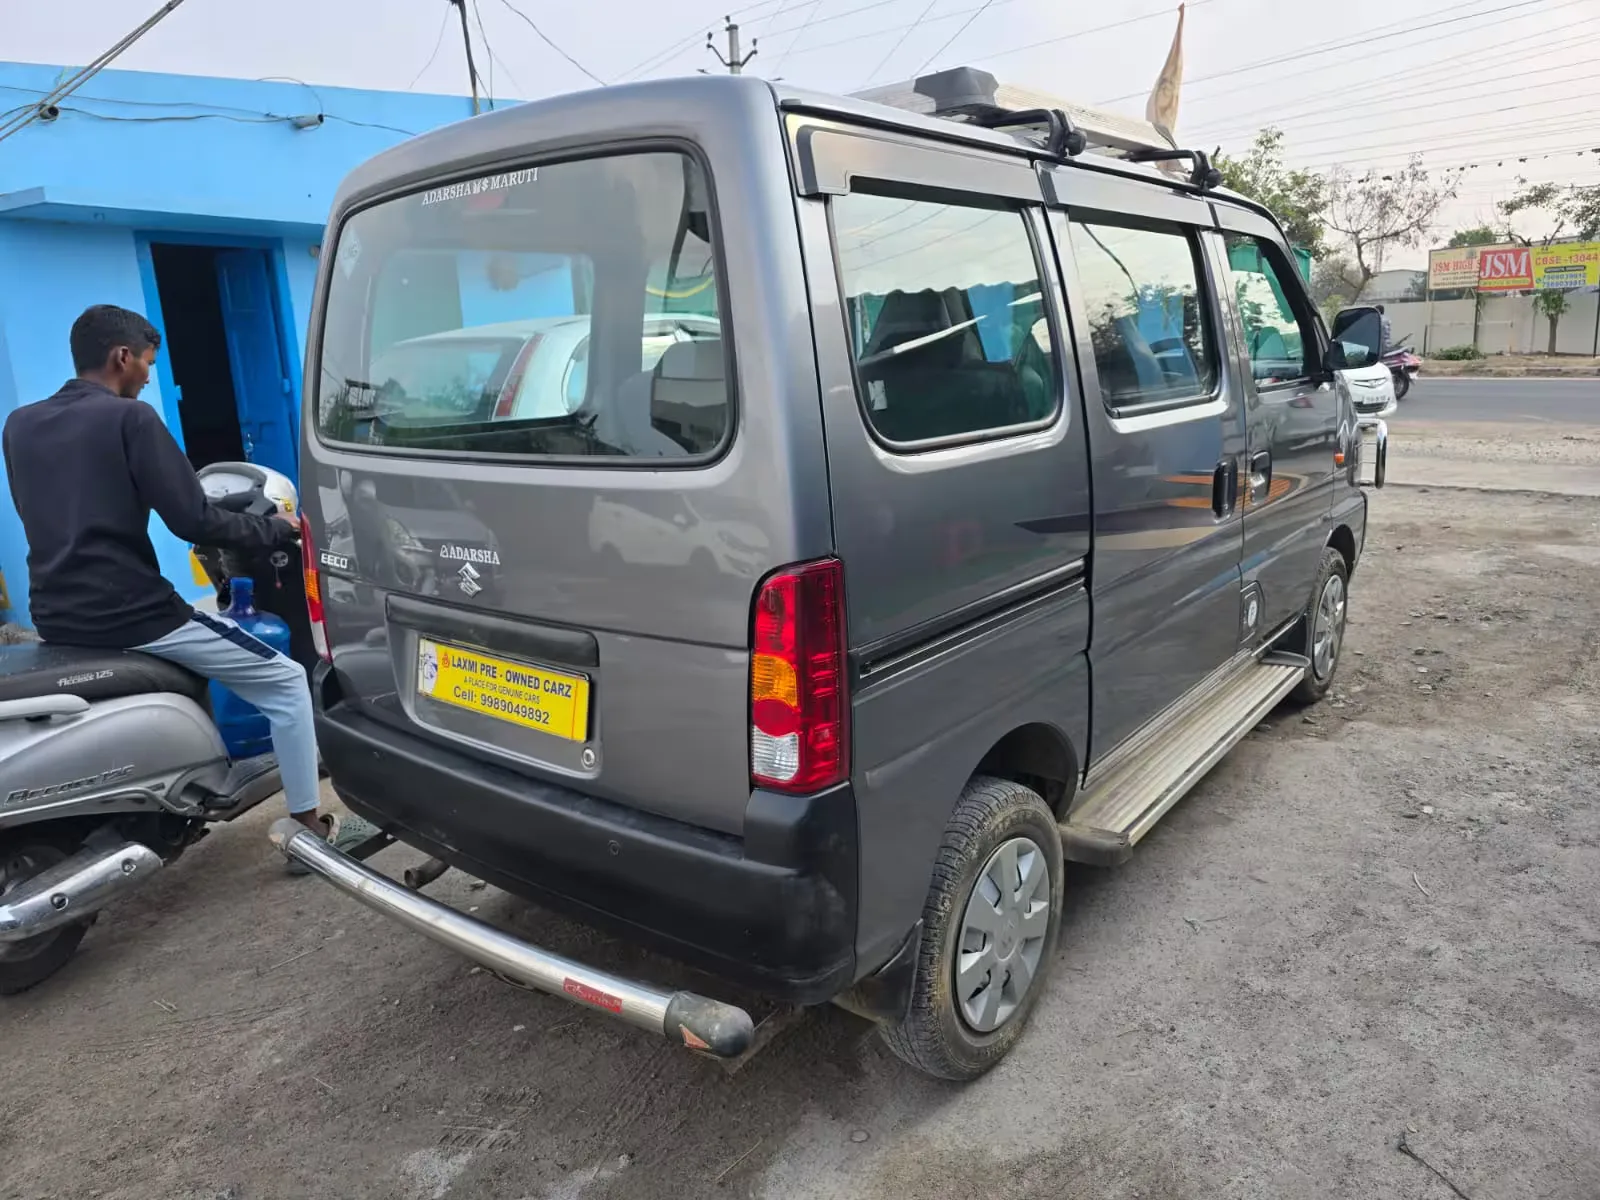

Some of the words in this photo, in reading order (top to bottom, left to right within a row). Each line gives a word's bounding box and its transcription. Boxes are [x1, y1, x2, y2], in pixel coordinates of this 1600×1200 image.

[422, 183, 471, 206] ADARSHA
[490, 167, 539, 190] MARUTI
[1432, 260, 1452, 273] JSM
[1453, 257, 1474, 271] HIGH
[1481, 251, 1529, 279] JSM
[320, 552, 348, 569] EECO
[449, 546, 500, 565] ADARSHA
[95, 669, 114, 681] 125
[451, 655, 478, 674] LAXMI
[480, 663, 497, 679] PRE
[505, 669, 540, 690] OWNED
[543, 678, 573, 699] CARZ
[453, 685, 477, 704] Cell:
[480, 693, 550, 725] 9989049892
[469, 677, 485, 689] PLACE
[486, 681, 498, 692] FOR
[498, 685, 523, 700] GENUINE
[523, 692, 541, 705] CARS
